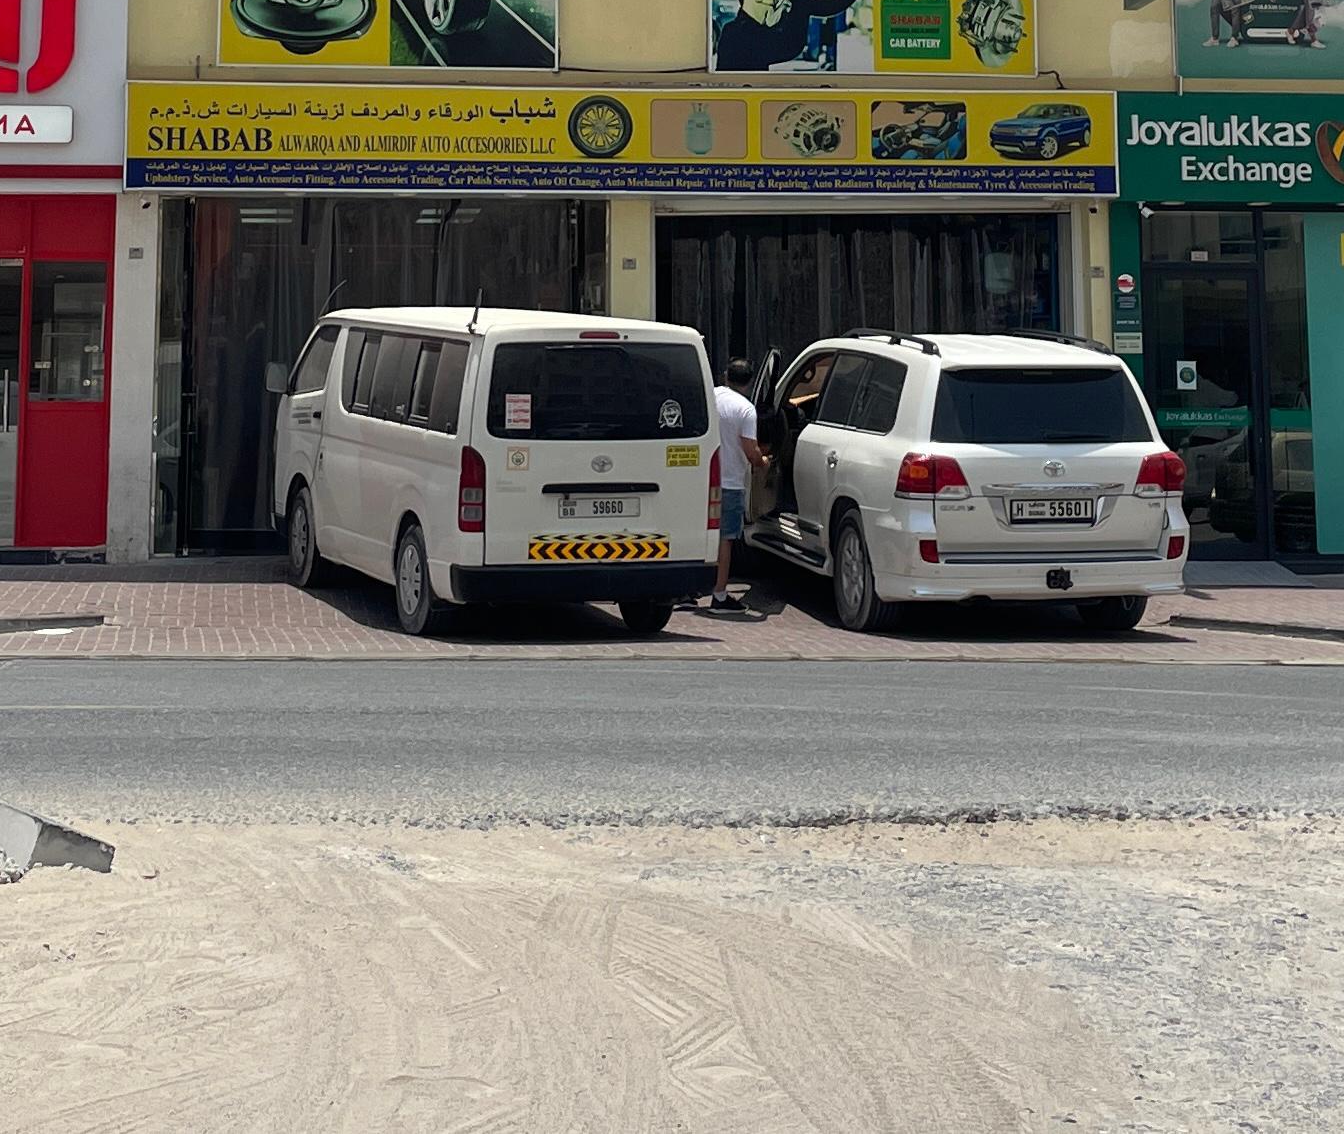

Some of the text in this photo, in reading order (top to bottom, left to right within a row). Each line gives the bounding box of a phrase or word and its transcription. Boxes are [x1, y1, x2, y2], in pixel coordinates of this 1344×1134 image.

[889, 38, 941, 48] CAR BATTERY
[225, 103, 298, 120] السيارات
[303, 100, 345, 121] لزينة
[351, 102, 422, 122] والمردف
[427, 102, 485, 122] الورقاء
[488, 96, 557, 125] شباب
[147, 126, 274, 153] SHABAB
[278, 135, 335, 155] ALWARQA
[338, 135, 361, 153] AND
[363, 135, 418, 153] ALMIRDIF
[421, 136, 451, 154] AUTO
[453, 137, 528, 154] ACCESOORIES
[1126, 114, 1312, 149] Joyalukkas
[1179, 155, 1313, 188] Exchange
[144, 172, 191, 185] Upholstery
[233, 174, 254, 184] Auto
[256, 174, 303, 184] Accessories
[339, 175, 359, 185] Auto
[362, 175, 408, 185] Accessories
[448, 175, 465, 185] Car
[467, 176, 492, 185] Polish
[532, 177, 553, 186] Auto
[554, 176, 567, 186] Oil
[605, 177, 626, 187] Auto
[627, 177, 674, 188] Mechanical
[728, 178, 756, 190] Fitting
[757, 179, 766, 188] &
[813, 180, 833, 189] Auto
[834, 179, 874, 189] Radiators
[875, 179, 916, 191] Repairing
[918, 180, 926, 189] &
[984, 180, 1007, 192] Tyres
[1008, 180, 1017, 190] &
[592, 500, 624, 515] 59660
[1048, 501, 1090, 517] 55601
